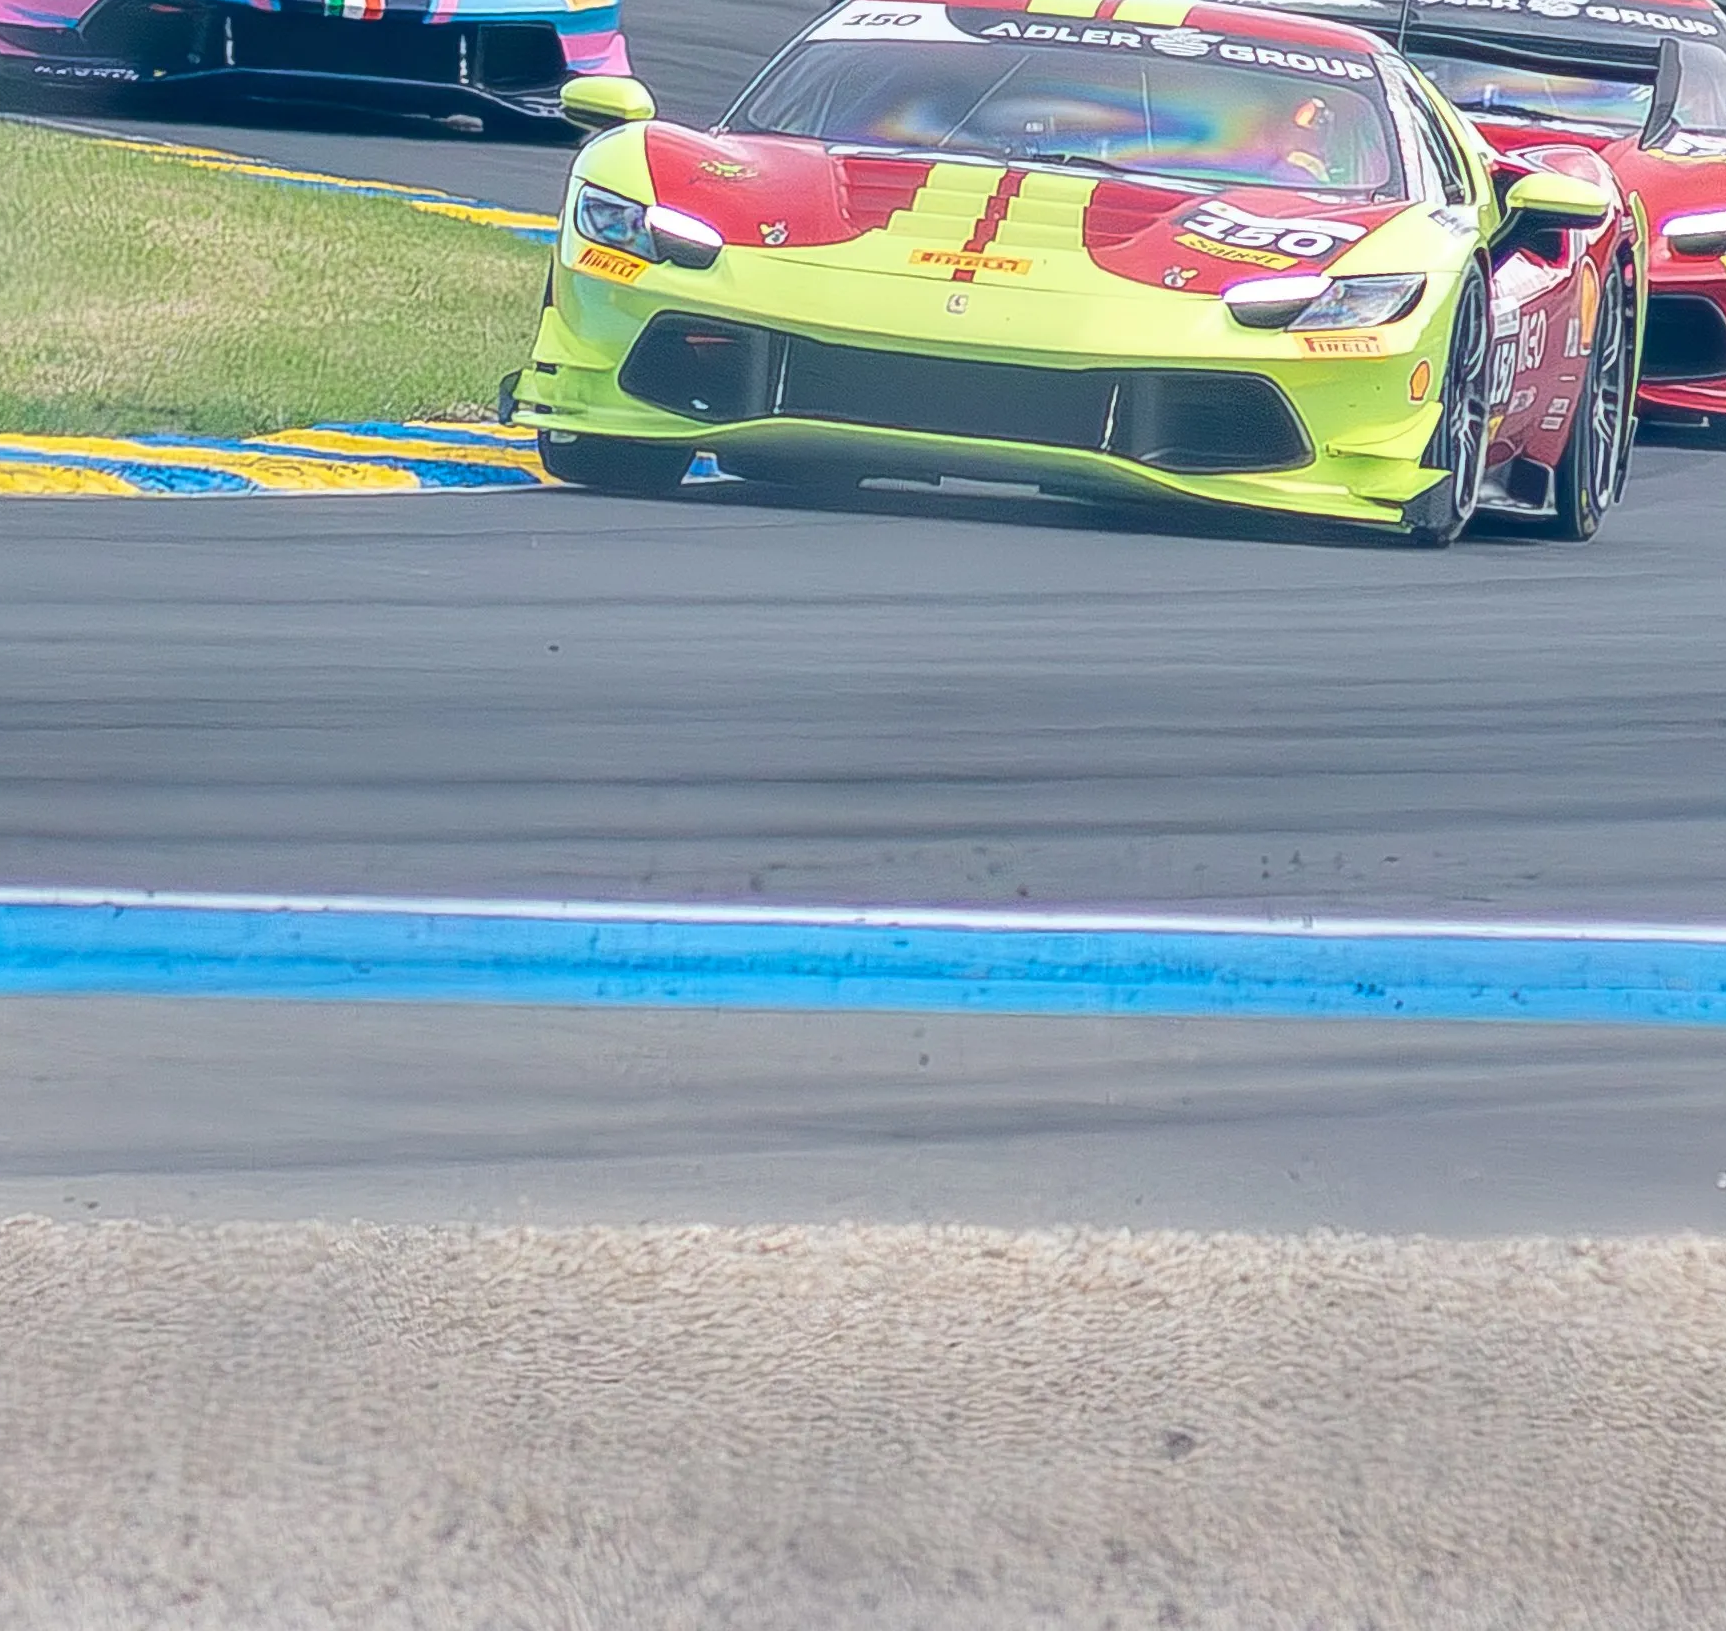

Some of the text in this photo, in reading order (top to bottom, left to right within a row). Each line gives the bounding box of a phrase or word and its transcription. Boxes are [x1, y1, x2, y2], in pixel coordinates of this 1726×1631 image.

[841, 12, 923, 27] 150
[1585, 6, 1719, 37] GROUP
[980, 21, 1376, 81] ADLER GROUP
[1182, 214, 1335, 258] 150
